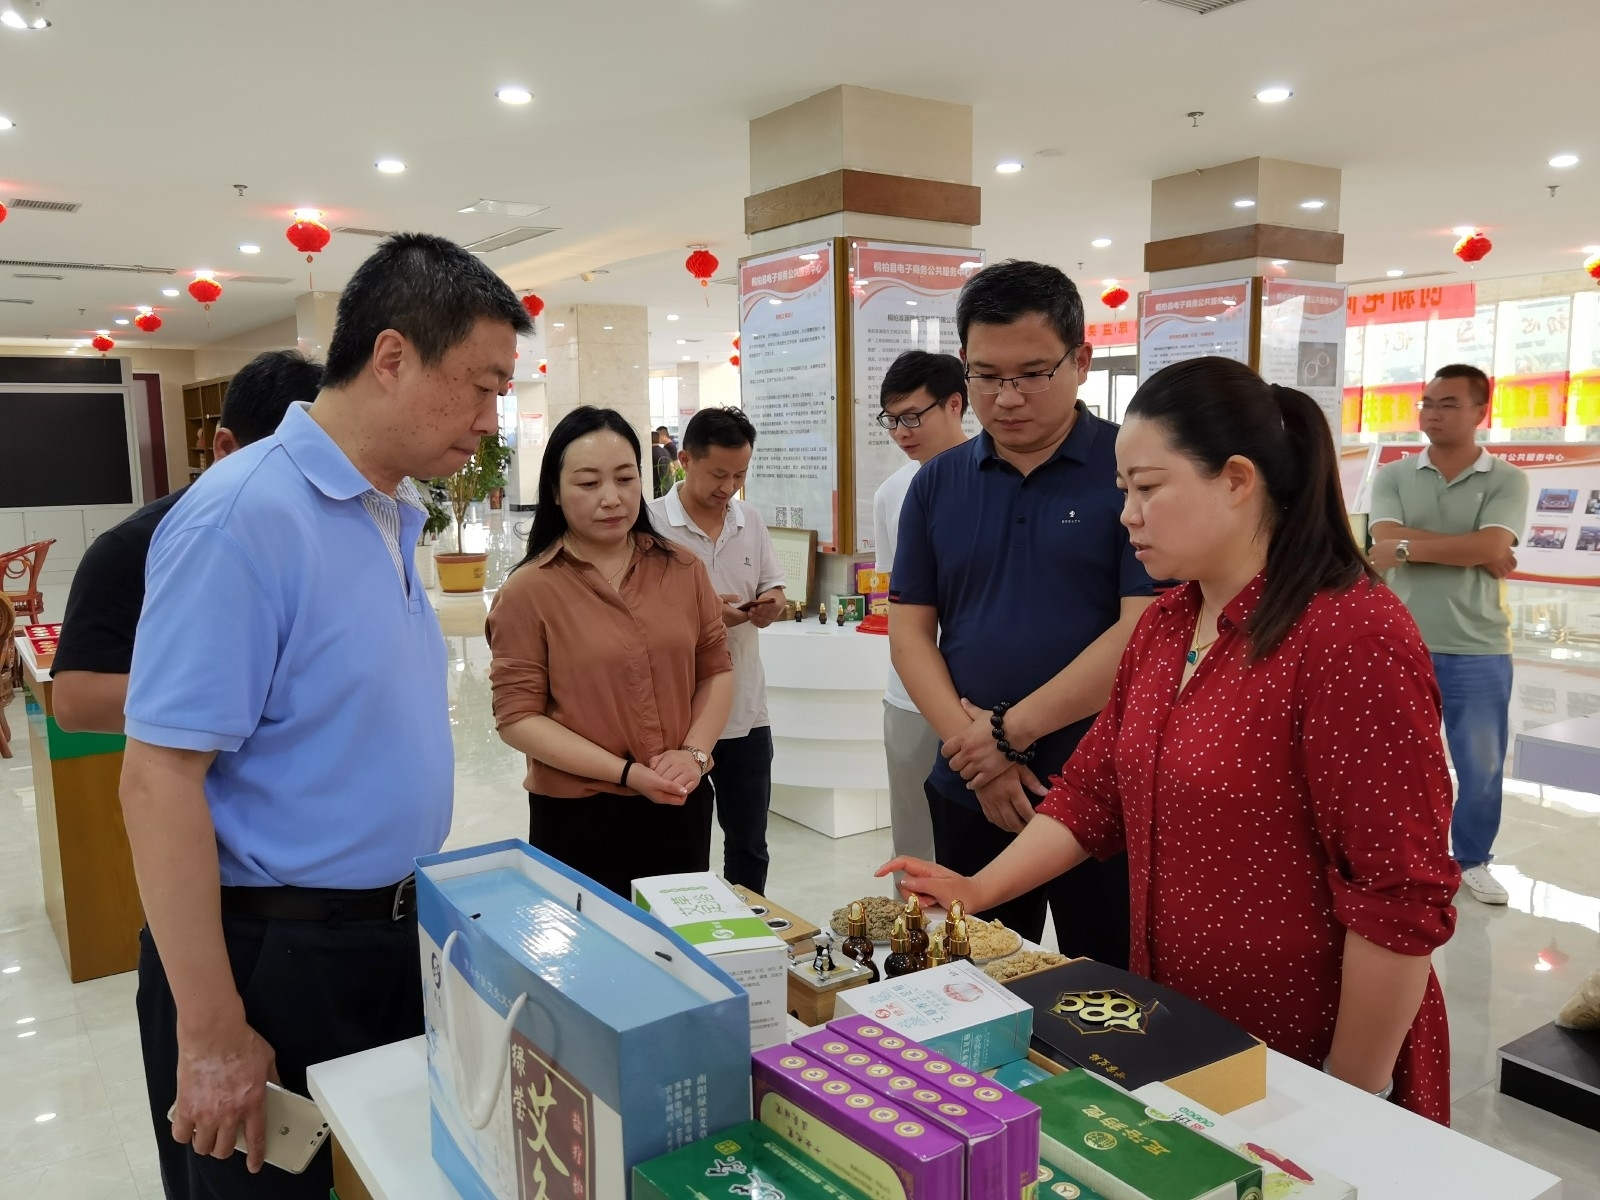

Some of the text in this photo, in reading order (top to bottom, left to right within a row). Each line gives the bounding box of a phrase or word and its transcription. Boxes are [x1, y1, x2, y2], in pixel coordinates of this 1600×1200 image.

[751, 264, 823, 288] 桐柏县电子商务公共服务中心
[873, 261, 972, 278] 桐柏县电子商务公共服务中心
[1081, 1104, 1171, 1156] 足浴药包
